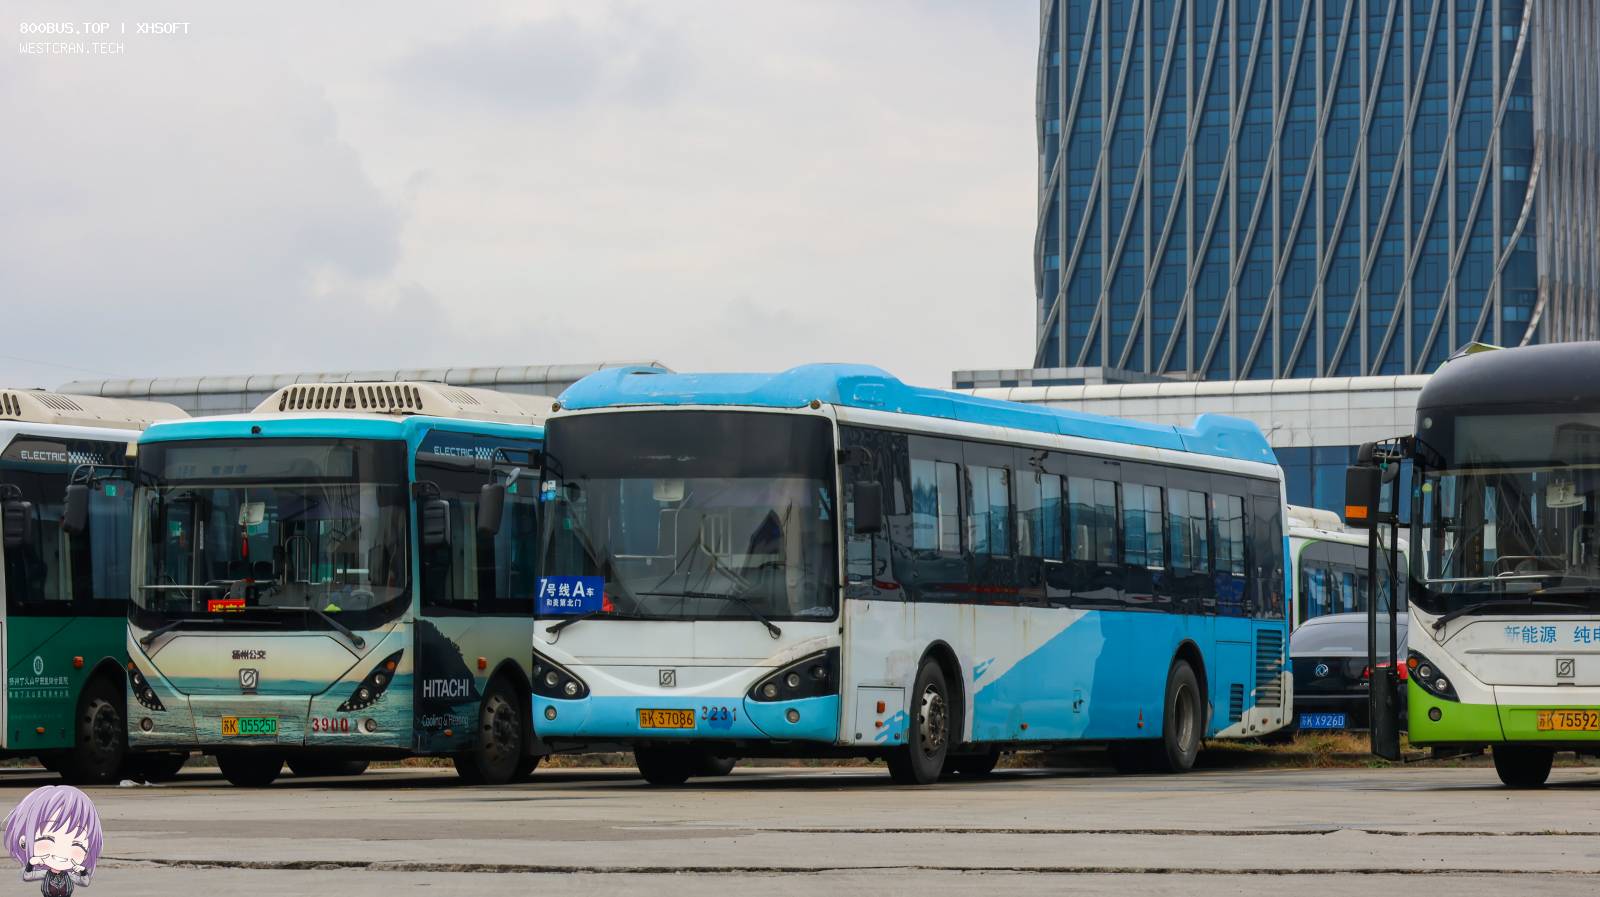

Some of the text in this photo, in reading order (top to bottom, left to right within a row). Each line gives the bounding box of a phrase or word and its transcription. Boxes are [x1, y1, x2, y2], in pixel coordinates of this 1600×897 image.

[21, 450, 66, 462] ELECTRIC
[434, 446, 474, 459] ELECTRIC
[1503, 625, 1557, 644] 新能源
[232, 650, 267, 660] 扬州公交
[423, 678, 470, 698] HITACHI
[312, 717, 350, 733] 3900
